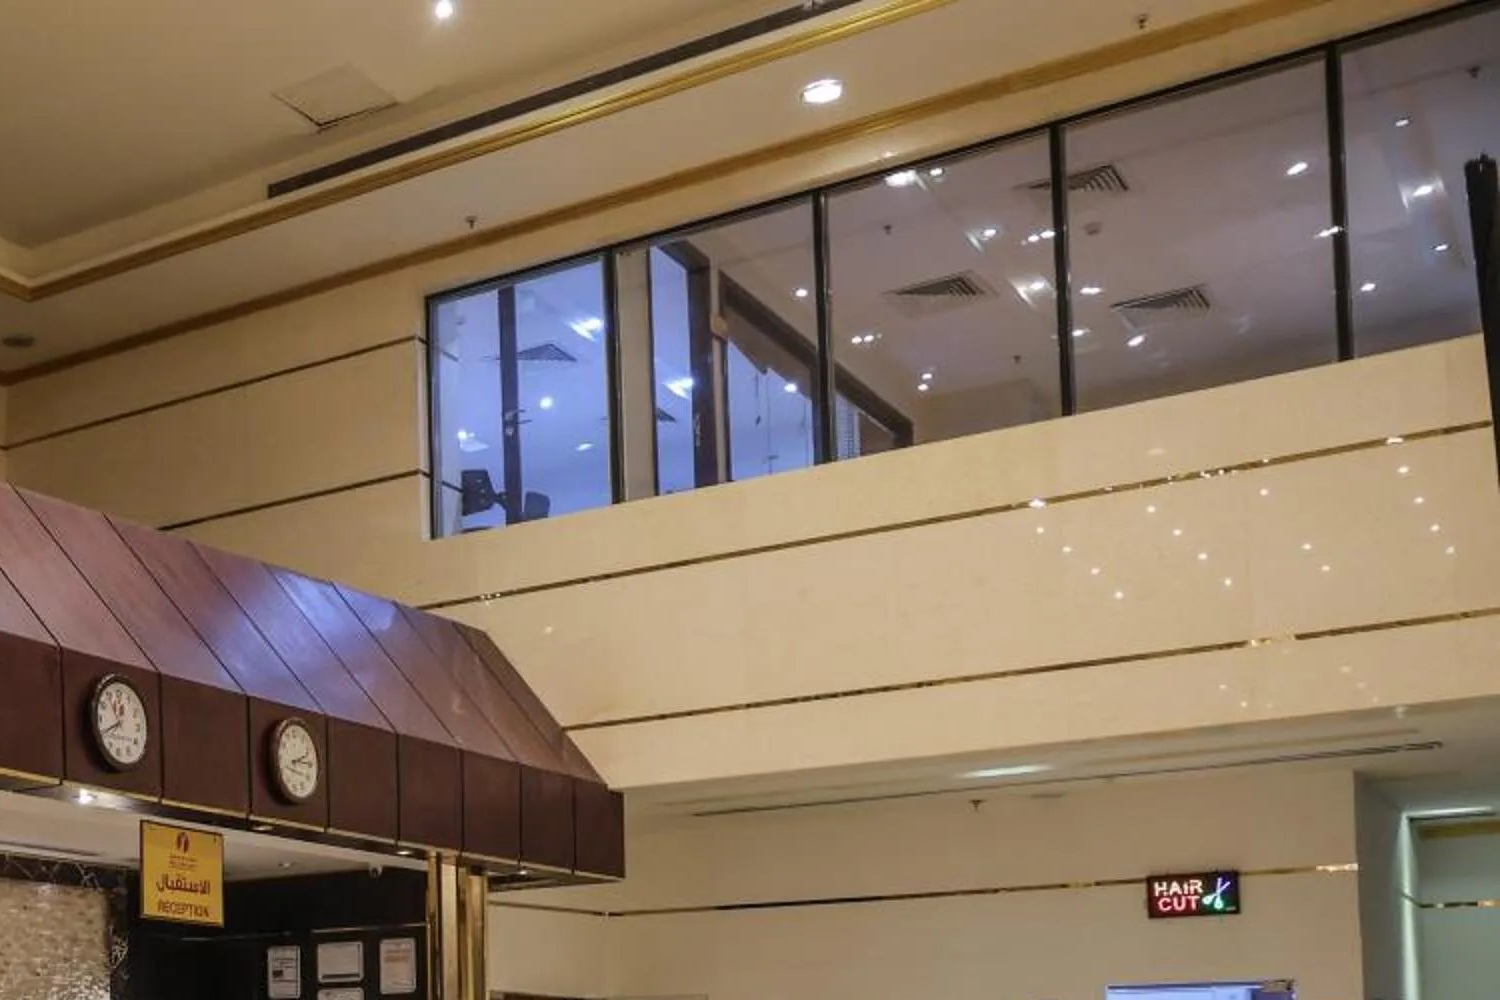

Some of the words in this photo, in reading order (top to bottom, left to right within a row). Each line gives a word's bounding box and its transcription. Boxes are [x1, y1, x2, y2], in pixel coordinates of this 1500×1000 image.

[1153, 879, 1204, 897] HAIR
[157, 899, 210, 918] RECEPTION
[1158, 896, 1200, 912] CUT
